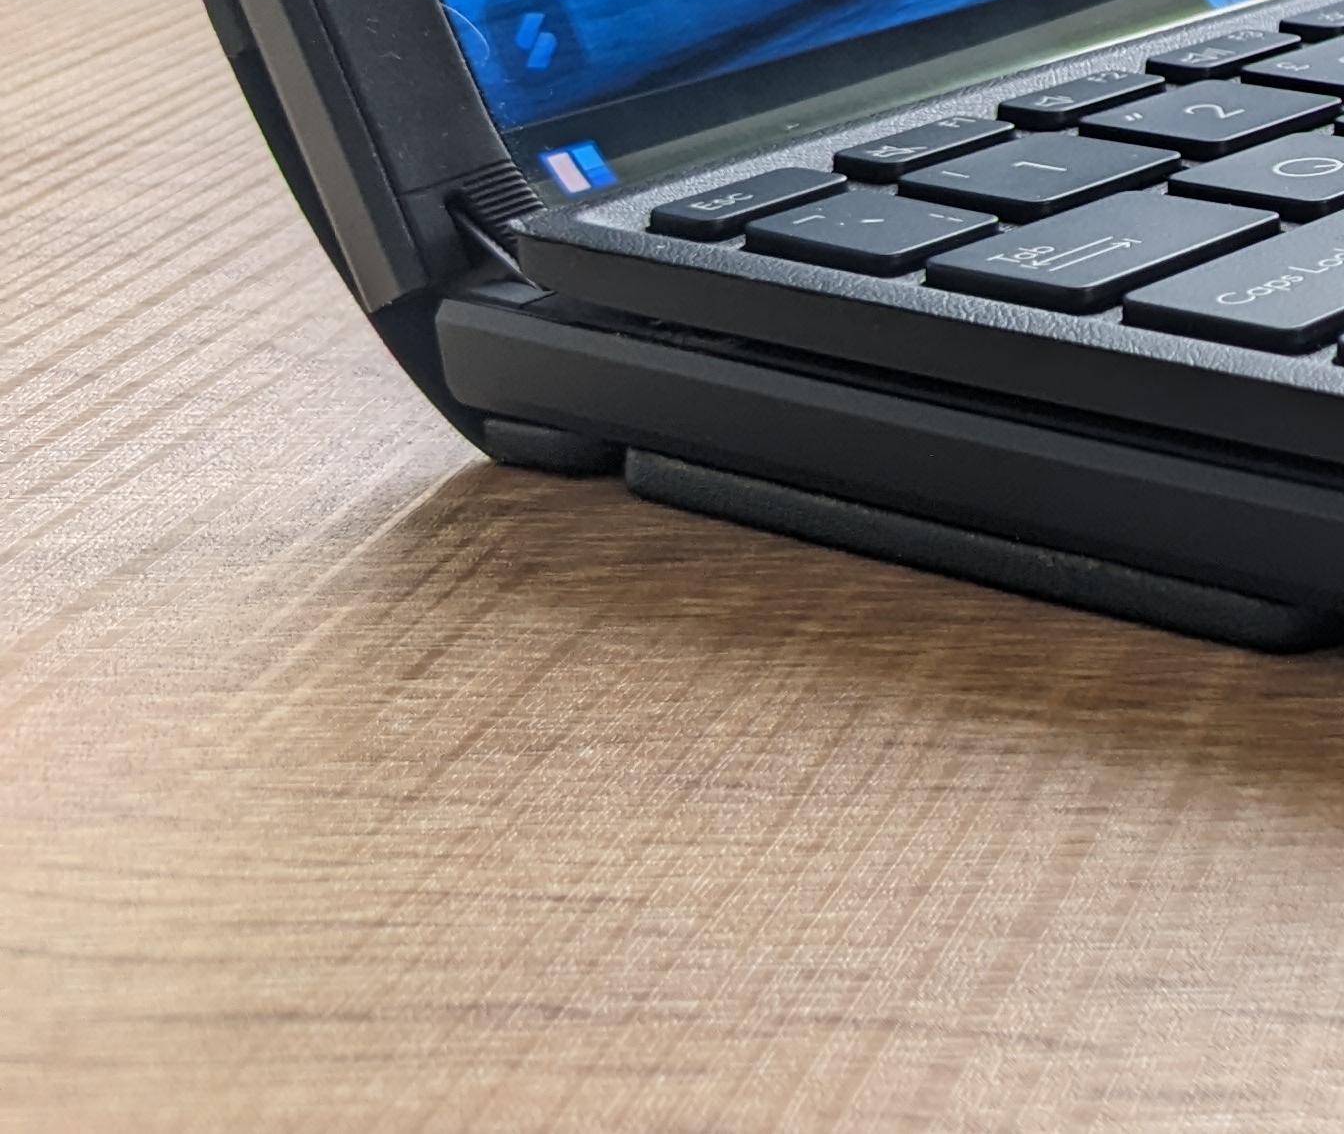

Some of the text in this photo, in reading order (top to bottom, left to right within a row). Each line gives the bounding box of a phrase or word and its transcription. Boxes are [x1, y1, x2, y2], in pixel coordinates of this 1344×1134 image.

[1181, 102, 1246, 120] 2
[938, 116, 977, 129] F1
[1010, 160, 1069, 173] 1
[690, 191, 755, 212] Esc
[984, 244, 1056, 264] Tab
[1214, 273, 1305, 306] Caps
